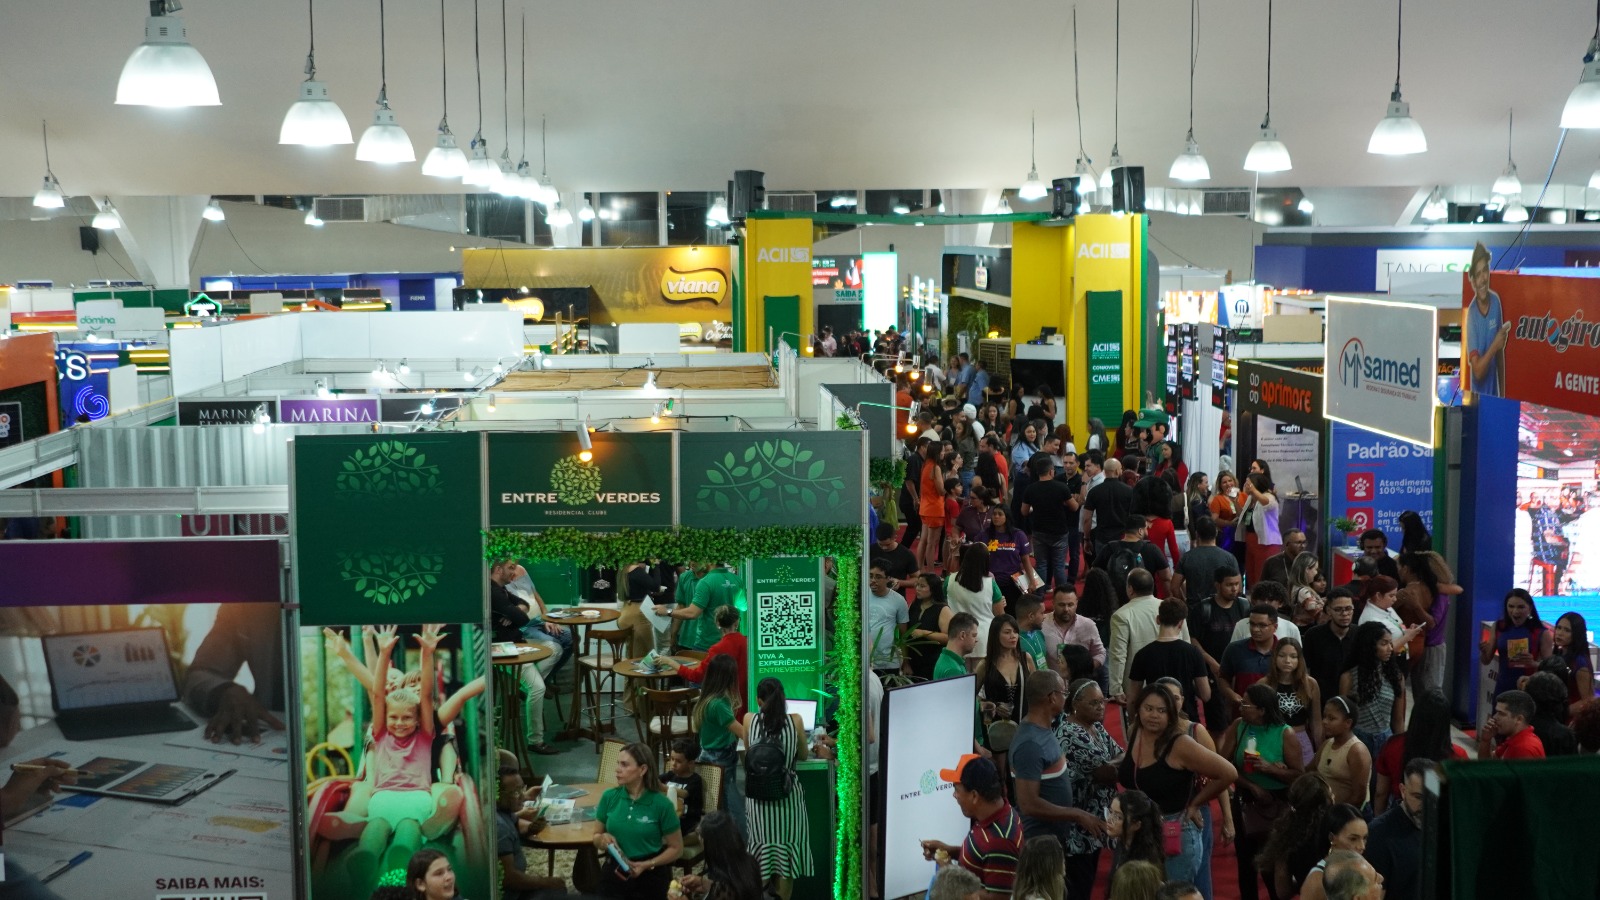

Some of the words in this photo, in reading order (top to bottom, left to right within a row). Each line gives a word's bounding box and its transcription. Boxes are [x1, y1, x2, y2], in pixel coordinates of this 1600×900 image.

[757, 247, 788, 262] ACII
[1078, 243, 1109, 259] ACII
[667, 276, 720, 294] viana
[1555, 371, 1563, 388] A
[1565, 373, 1599, 395] GENTE
[1261, 378, 1312, 413] aprimore
[290, 408, 372, 422] MARINA
[1348, 442, 1409, 460] Padrão
[501, 493, 558, 504] ENTRE
[596, 492, 661, 504] VERDES
[758, 658, 811, 666] EXPERIÊNCIA
[759, 666, 816, 674] ENTREVERDES
[900, 790, 921, 800] ENTRE
[155, 877, 209, 890] SAIBA
[214, 876, 265, 889] MAIS:
